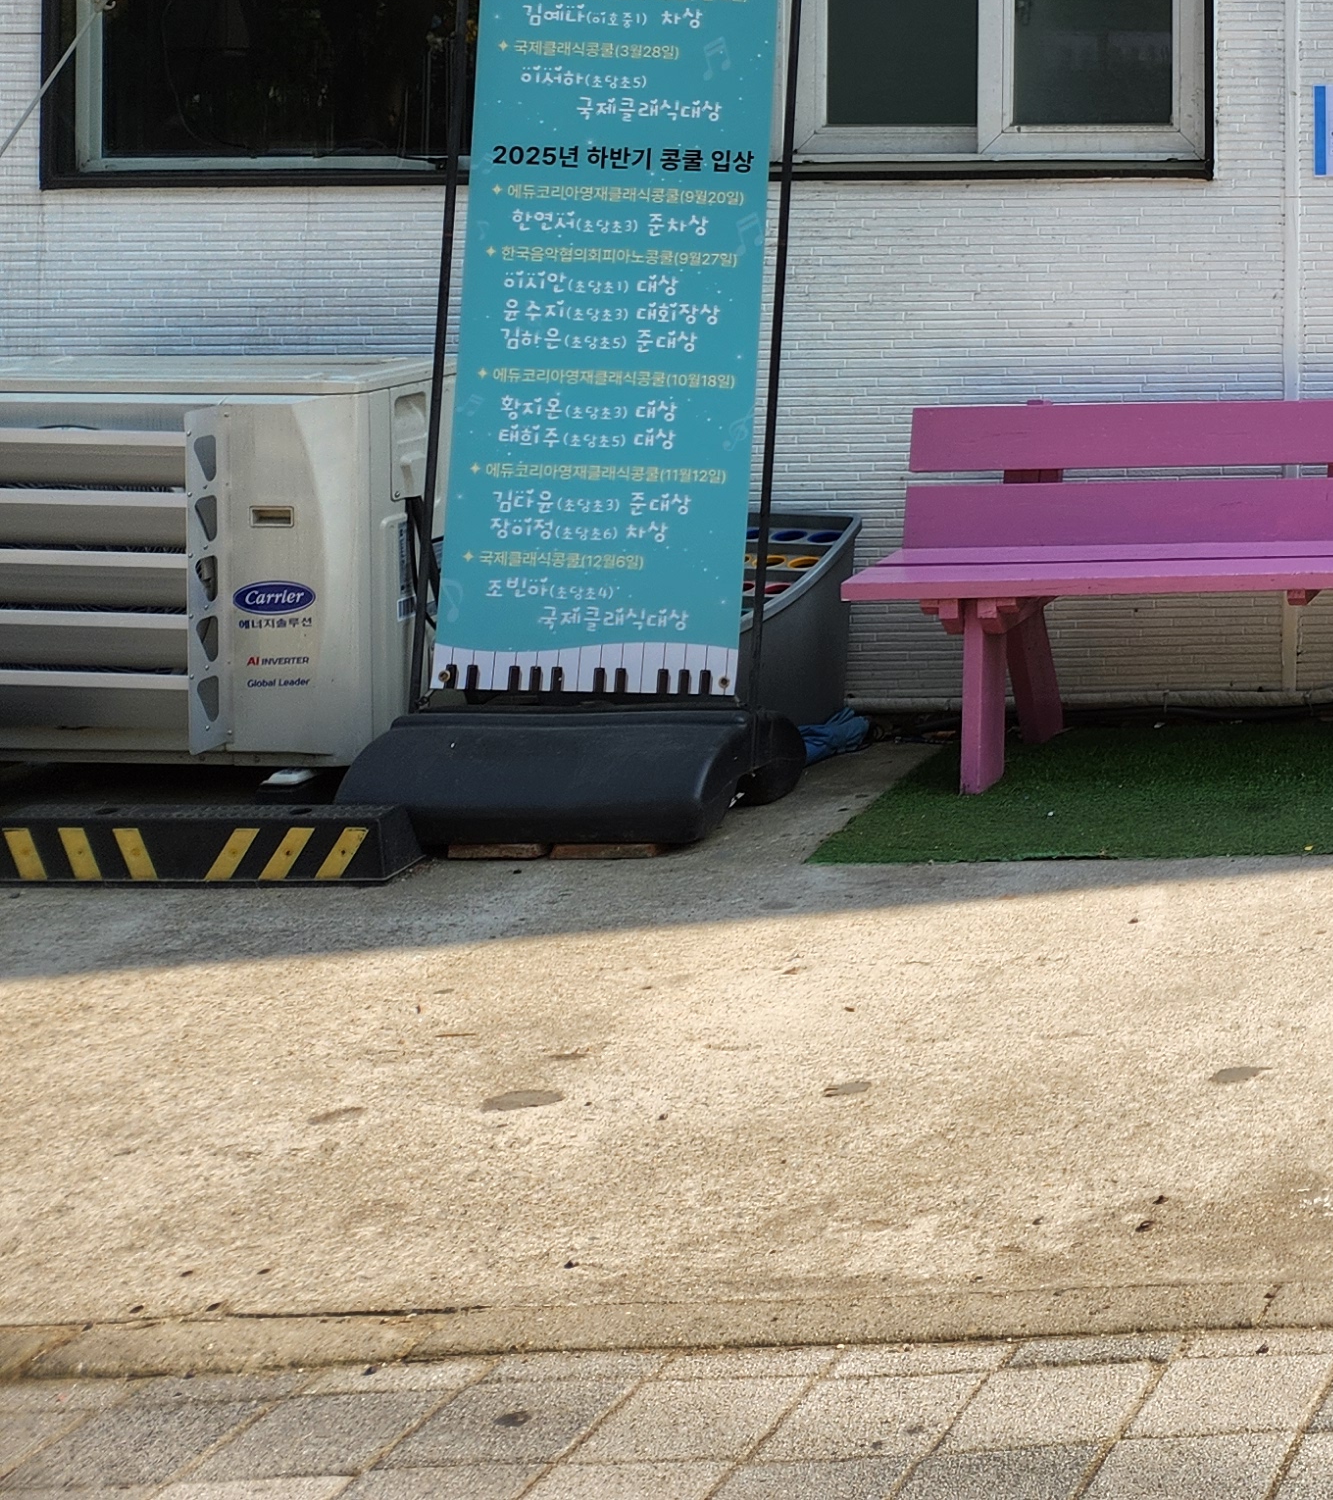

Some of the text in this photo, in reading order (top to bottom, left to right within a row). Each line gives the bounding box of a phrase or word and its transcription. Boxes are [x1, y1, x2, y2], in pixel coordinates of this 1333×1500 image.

[661, 7, 703, 28] 차상
[576, 97, 722, 122] 국제클래식대상
[492, 145, 754, 173] 2025년 하반기 콩쿨 입상
[648, 213, 709, 236] 준차상
[637, 274, 679, 296] 대상
[636, 303, 721, 325] 대회장상
[636, 329, 698, 353] 준대상
[636, 400, 677, 422] 대상
[634, 428, 676, 450] 대상
[629, 492, 691, 515] 준대상
[626, 521, 668, 543] 차상
[245, 590, 305, 605] Carrier
[538, 605, 689, 631] 국제클래식대상
[247, 677, 310, 688] Global Leader
